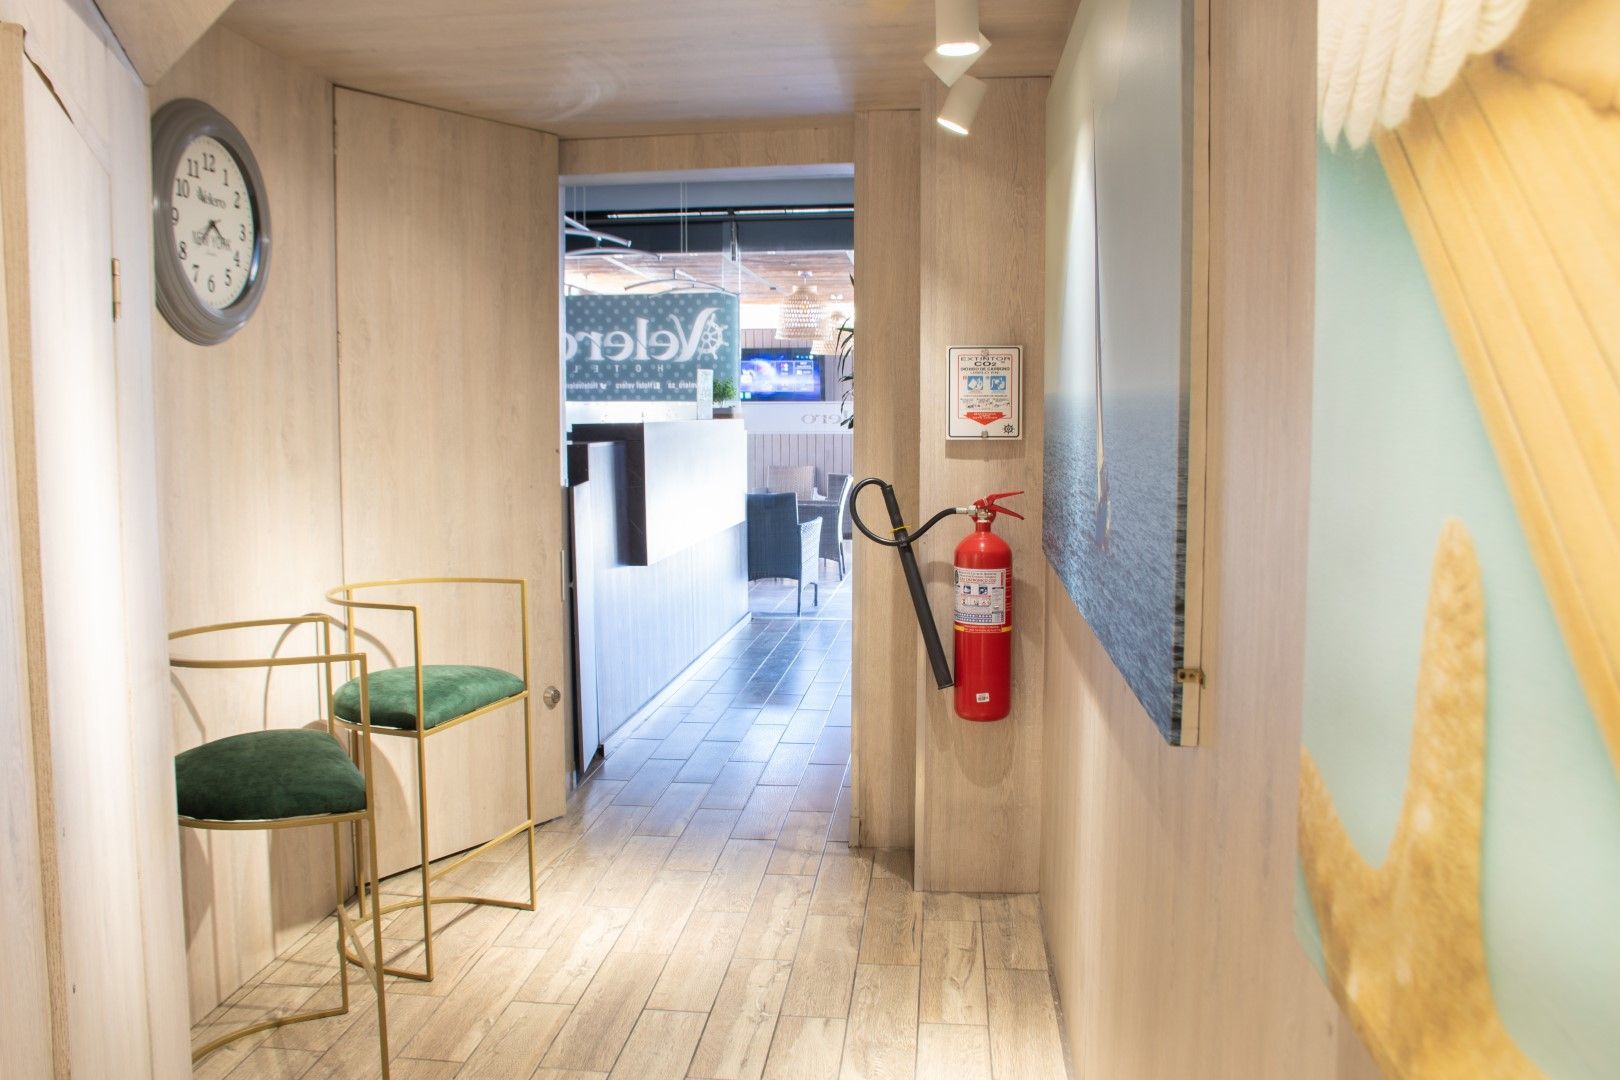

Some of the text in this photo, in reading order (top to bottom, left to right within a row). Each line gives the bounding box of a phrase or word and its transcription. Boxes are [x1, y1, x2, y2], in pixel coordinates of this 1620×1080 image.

[187, 158, 200, 179] 11
[203, 152, 216, 172] 12
[223, 168, 229, 187] 1
[176, 178, 190, 198] 10
[234, 191, 241, 209] 2
[172, 207, 179, 226] 9
[240, 223, 246, 242] 3
[179, 241, 187, 260] 8
[233, 250, 240, 267] 4
[192, 264, 199, 283] 7
[225, 268, 232, 287] 5
[208, 274, 215, 293] 6
